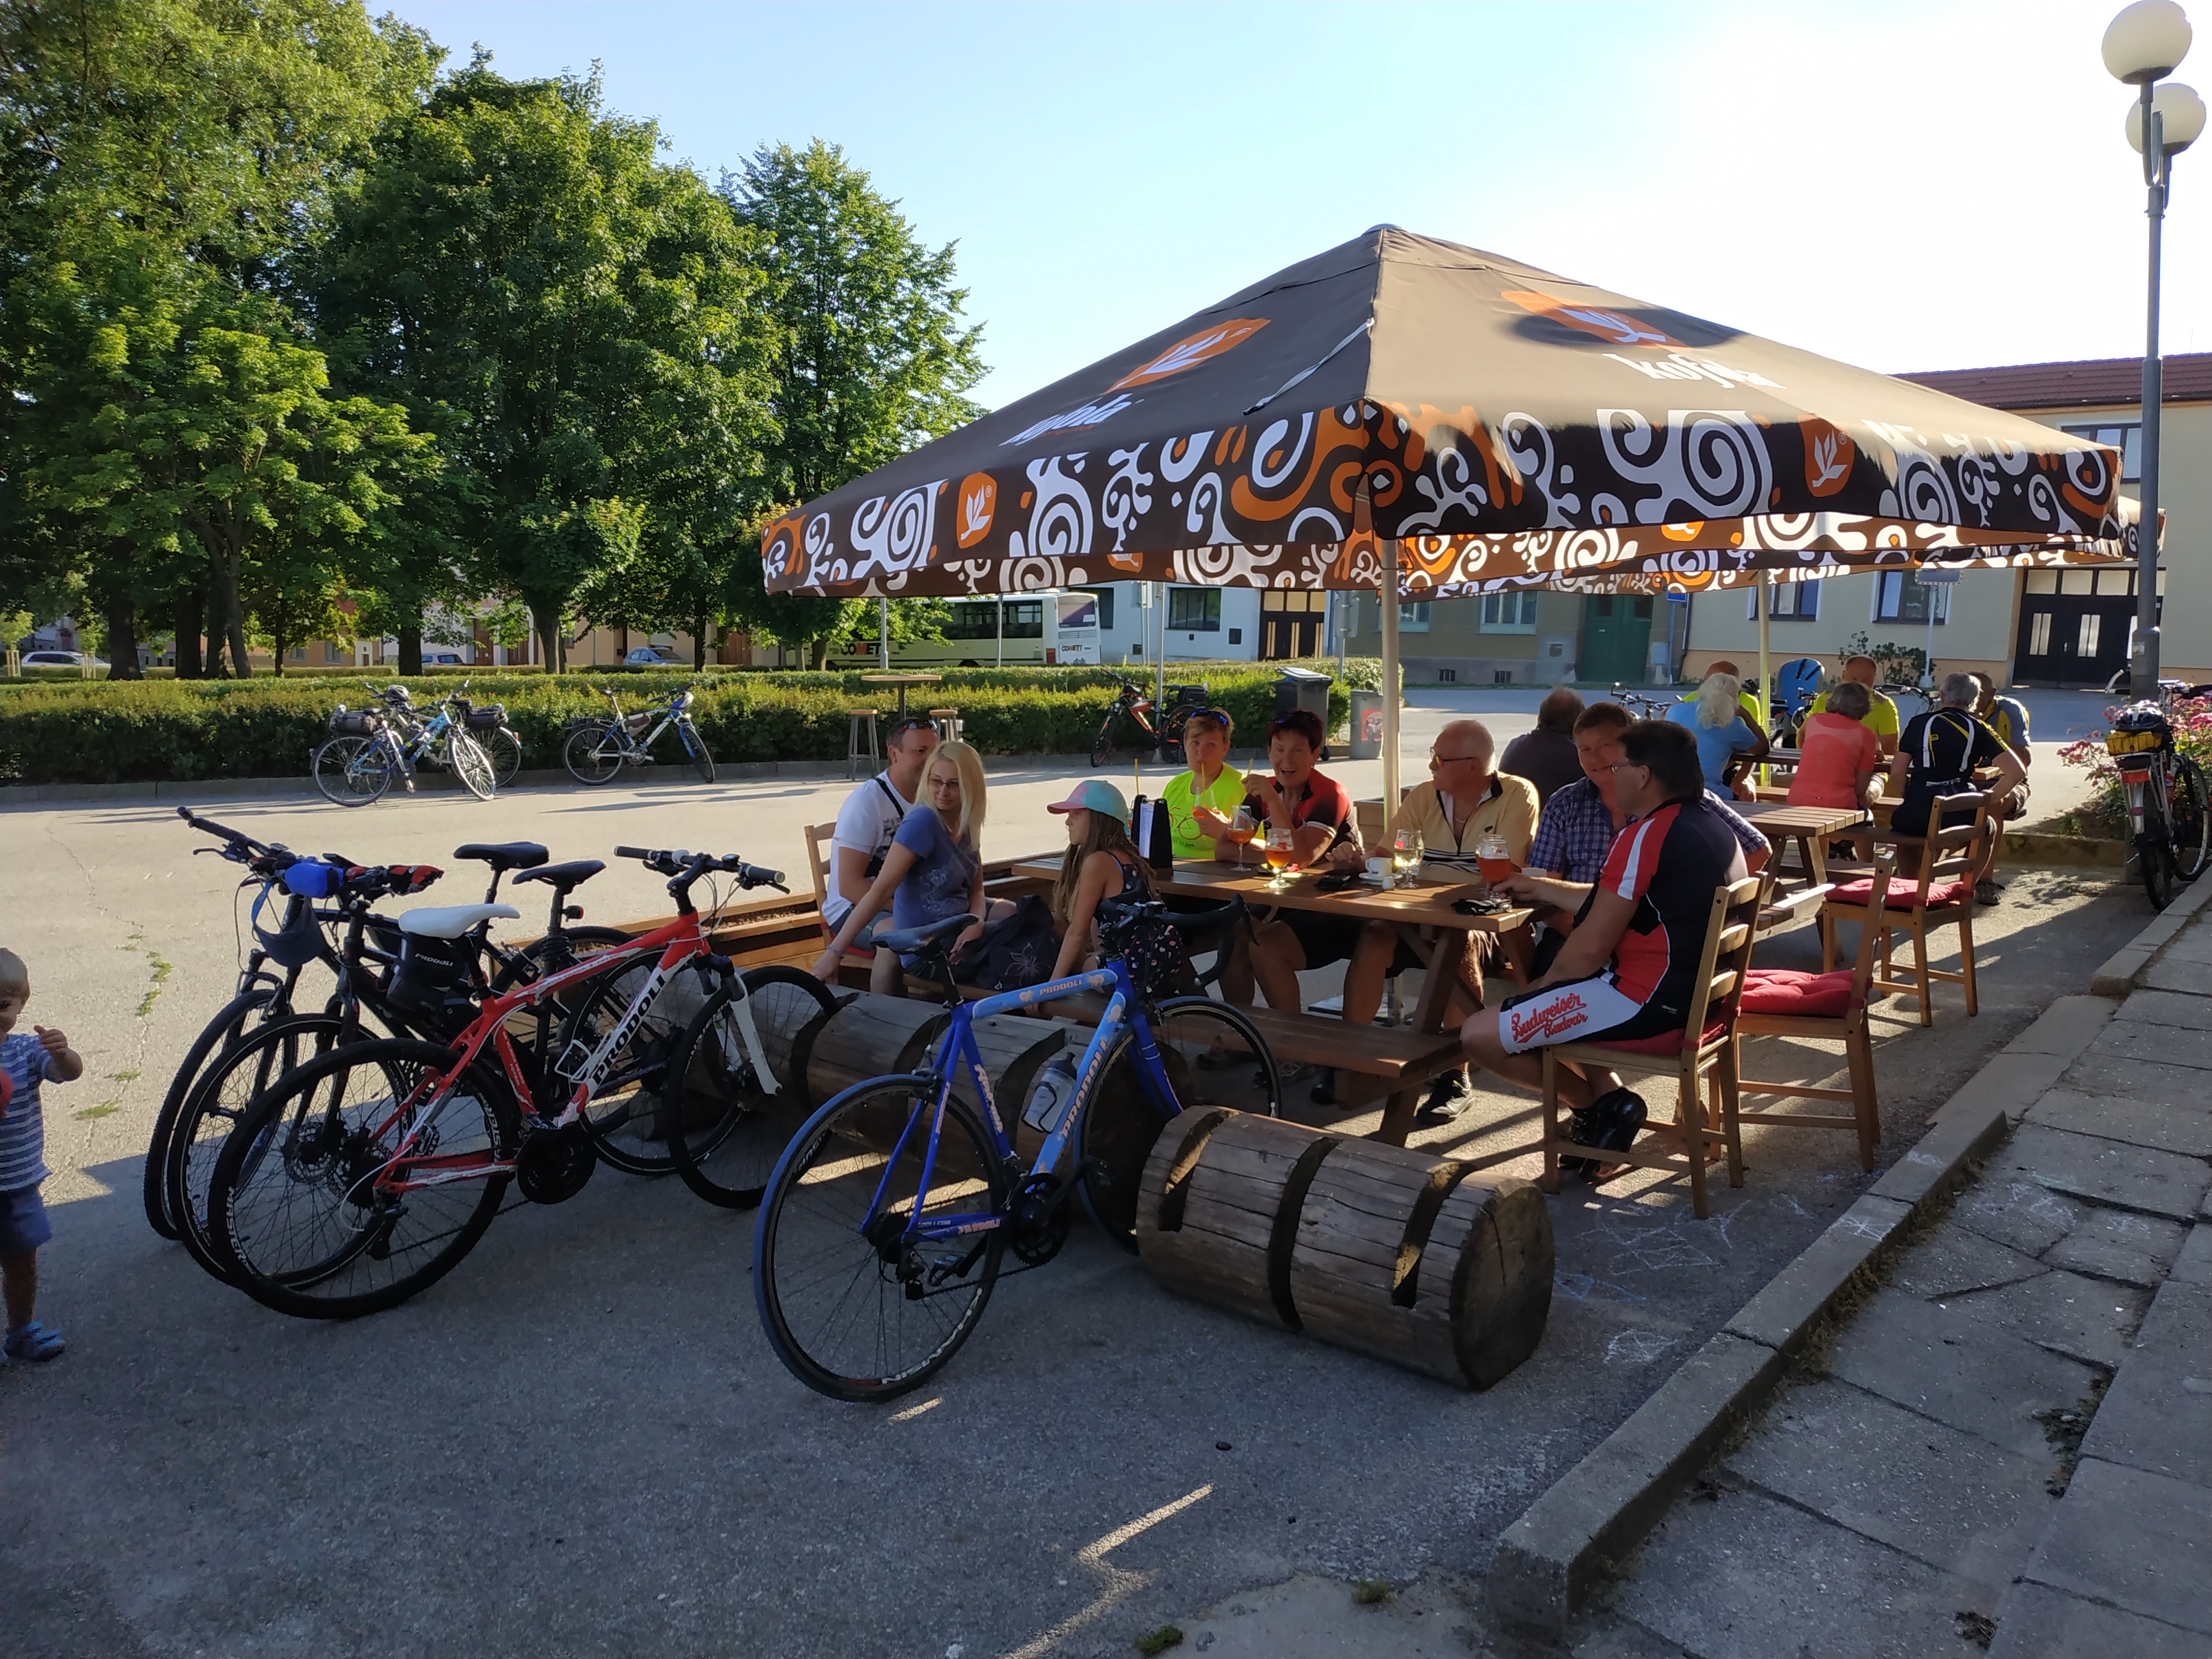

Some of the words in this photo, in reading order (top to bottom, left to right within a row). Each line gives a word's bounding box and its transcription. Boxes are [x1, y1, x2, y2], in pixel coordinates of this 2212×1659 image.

[841, 643, 889, 656] COMET
[414, 952, 453, 967] PRODOLI
[1039, 979, 1082, 995] PRODOLI
[592, 973, 665, 1085] PRODOLI
[1511, 993, 1587, 1042] Budweiser
[1544, 1012, 1588, 1038] Budvar
[506, 1041, 516, 1063] SLAVIA
[515, 1063, 525, 1085] PRAHA
[509, 1063, 520, 1086] FOTBAL
[1061, 1040, 1107, 1139] PRODOLI
[226, 1186, 247, 1260] MASTER
[881, 1287, 983, 1385] KHAMSIN
